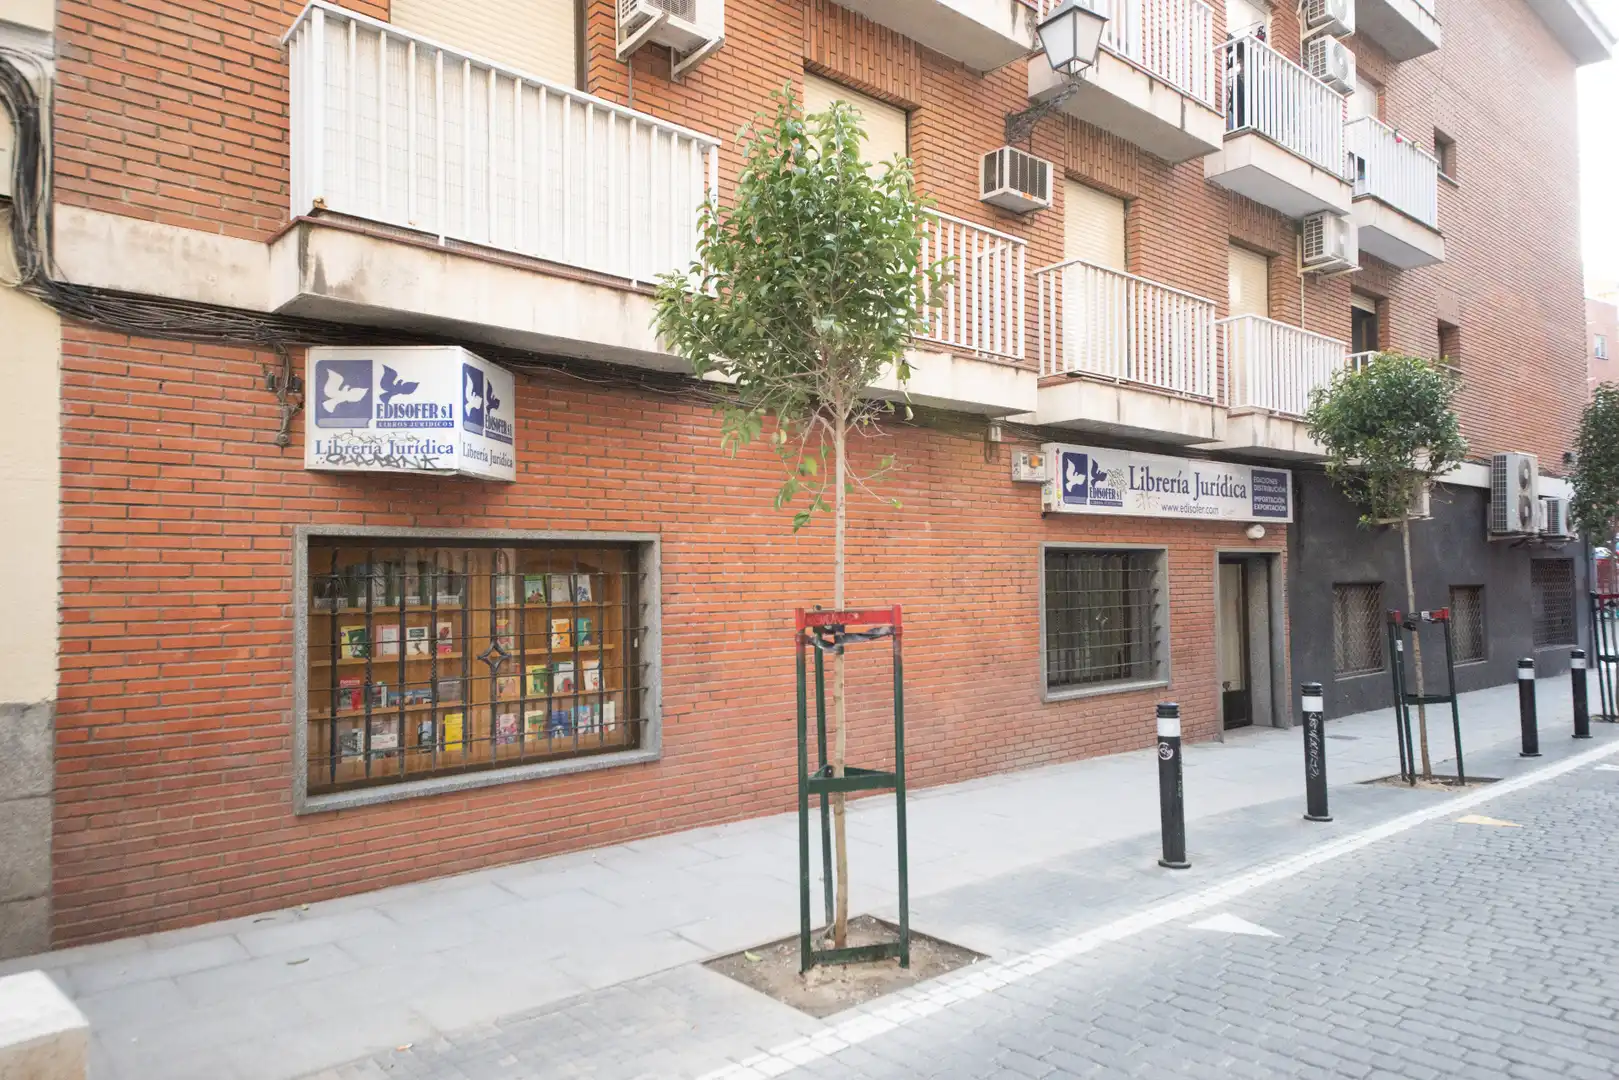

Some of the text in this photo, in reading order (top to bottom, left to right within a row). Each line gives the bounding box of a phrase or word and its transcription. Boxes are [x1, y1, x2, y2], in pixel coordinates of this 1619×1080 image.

[376, 403, 438, 419] EDISOFER
[315, 439, 454, 456] Librería Jurídica
[463, 442, 488, 462] Librería
[489, 449, 513, 468] Jurídica
[1128, 465, 1190, 495] Librería
[1193, 471, 1247, 500] Jurídica
[1089, 487, 1116, 500] EDISOFER
[1161, 502, 1219, 514] www.edisofer.com
